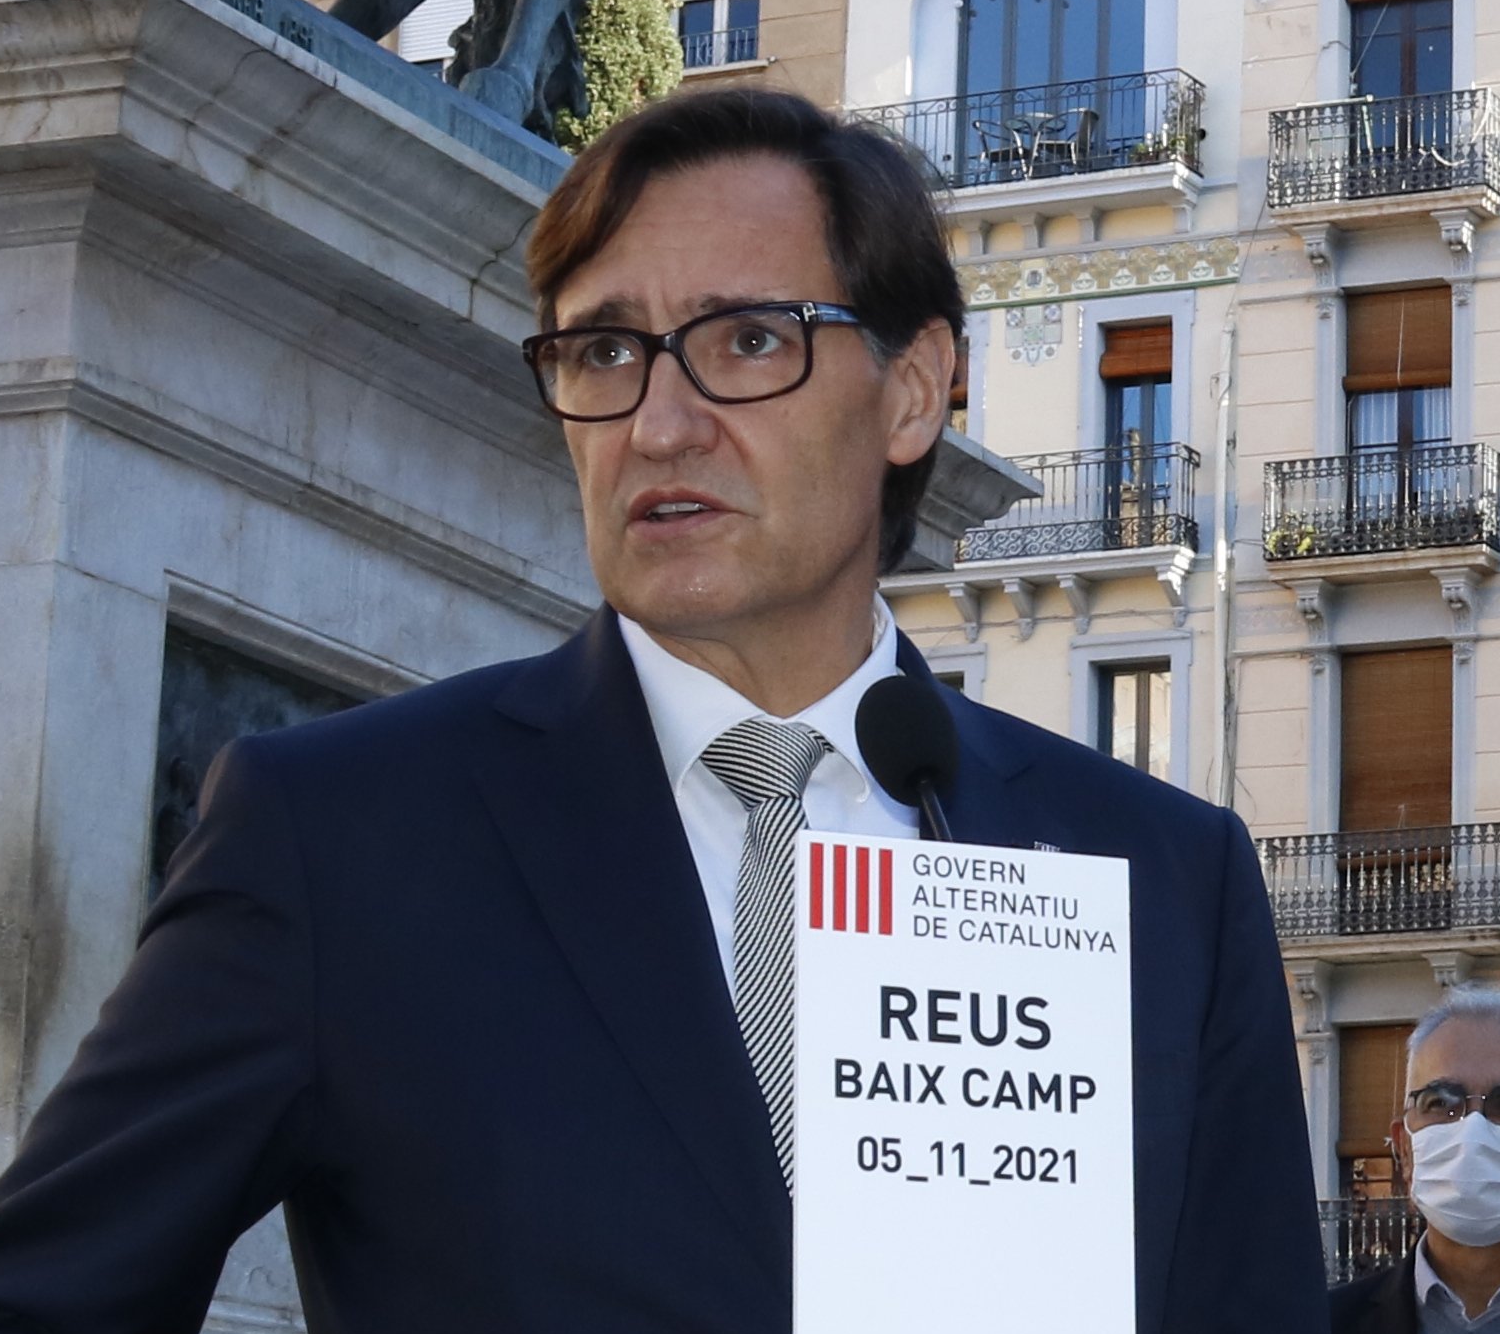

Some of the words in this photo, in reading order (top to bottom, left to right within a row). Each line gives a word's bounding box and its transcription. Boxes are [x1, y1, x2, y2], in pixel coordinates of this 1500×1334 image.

[911, 853, 1026, 886] GOVERN
[911, 884, 1079, 921] ALTERNATIU
[912, 914, 948, 940] DE
[958, 919, 1117, 954] CATALUNYA
[879, 985, 1053, 1050] REUS
[833, 1058, 947, 1106] BAIX
[961, 1067, 1098, 1114] CAMP
[856, 1135, 1079, 1186] 05_11_2021
